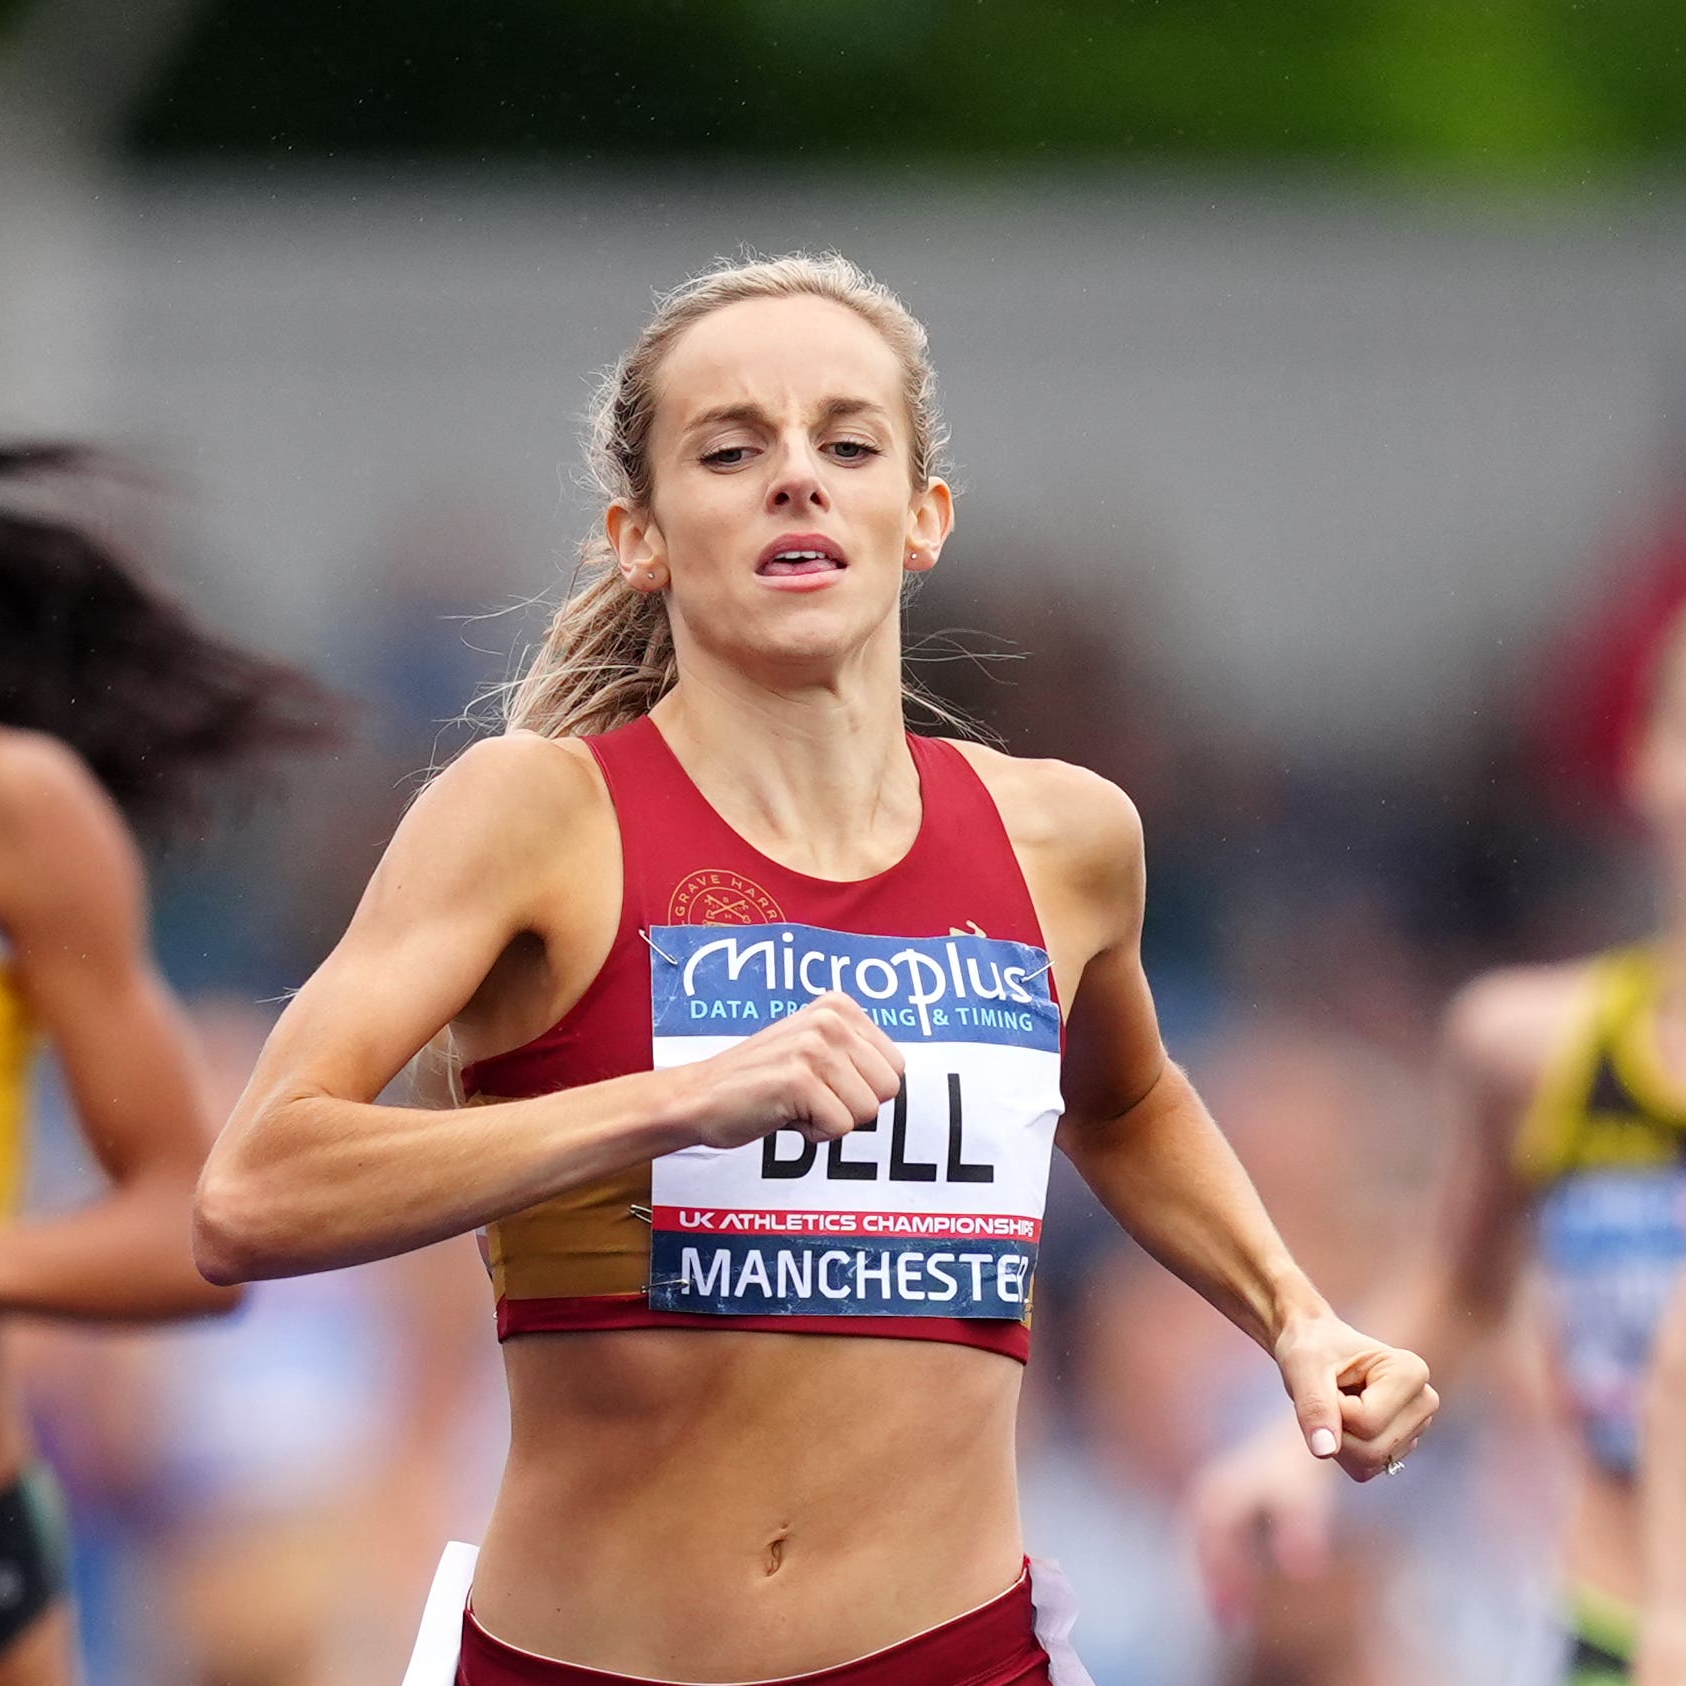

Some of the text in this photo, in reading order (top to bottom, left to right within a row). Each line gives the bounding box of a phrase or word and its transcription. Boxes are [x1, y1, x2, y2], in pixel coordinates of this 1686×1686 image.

[682, 931, 1033, 1036] Microplus
[690, 999, 759, 1020] DATA
[933, 1009, 949, 1027] &
[956, 1007, 1033, 1032] TIMING
[679, 1210, 716, 1231] UK
[718, 1212, 857, 1232] ATHLETICS
